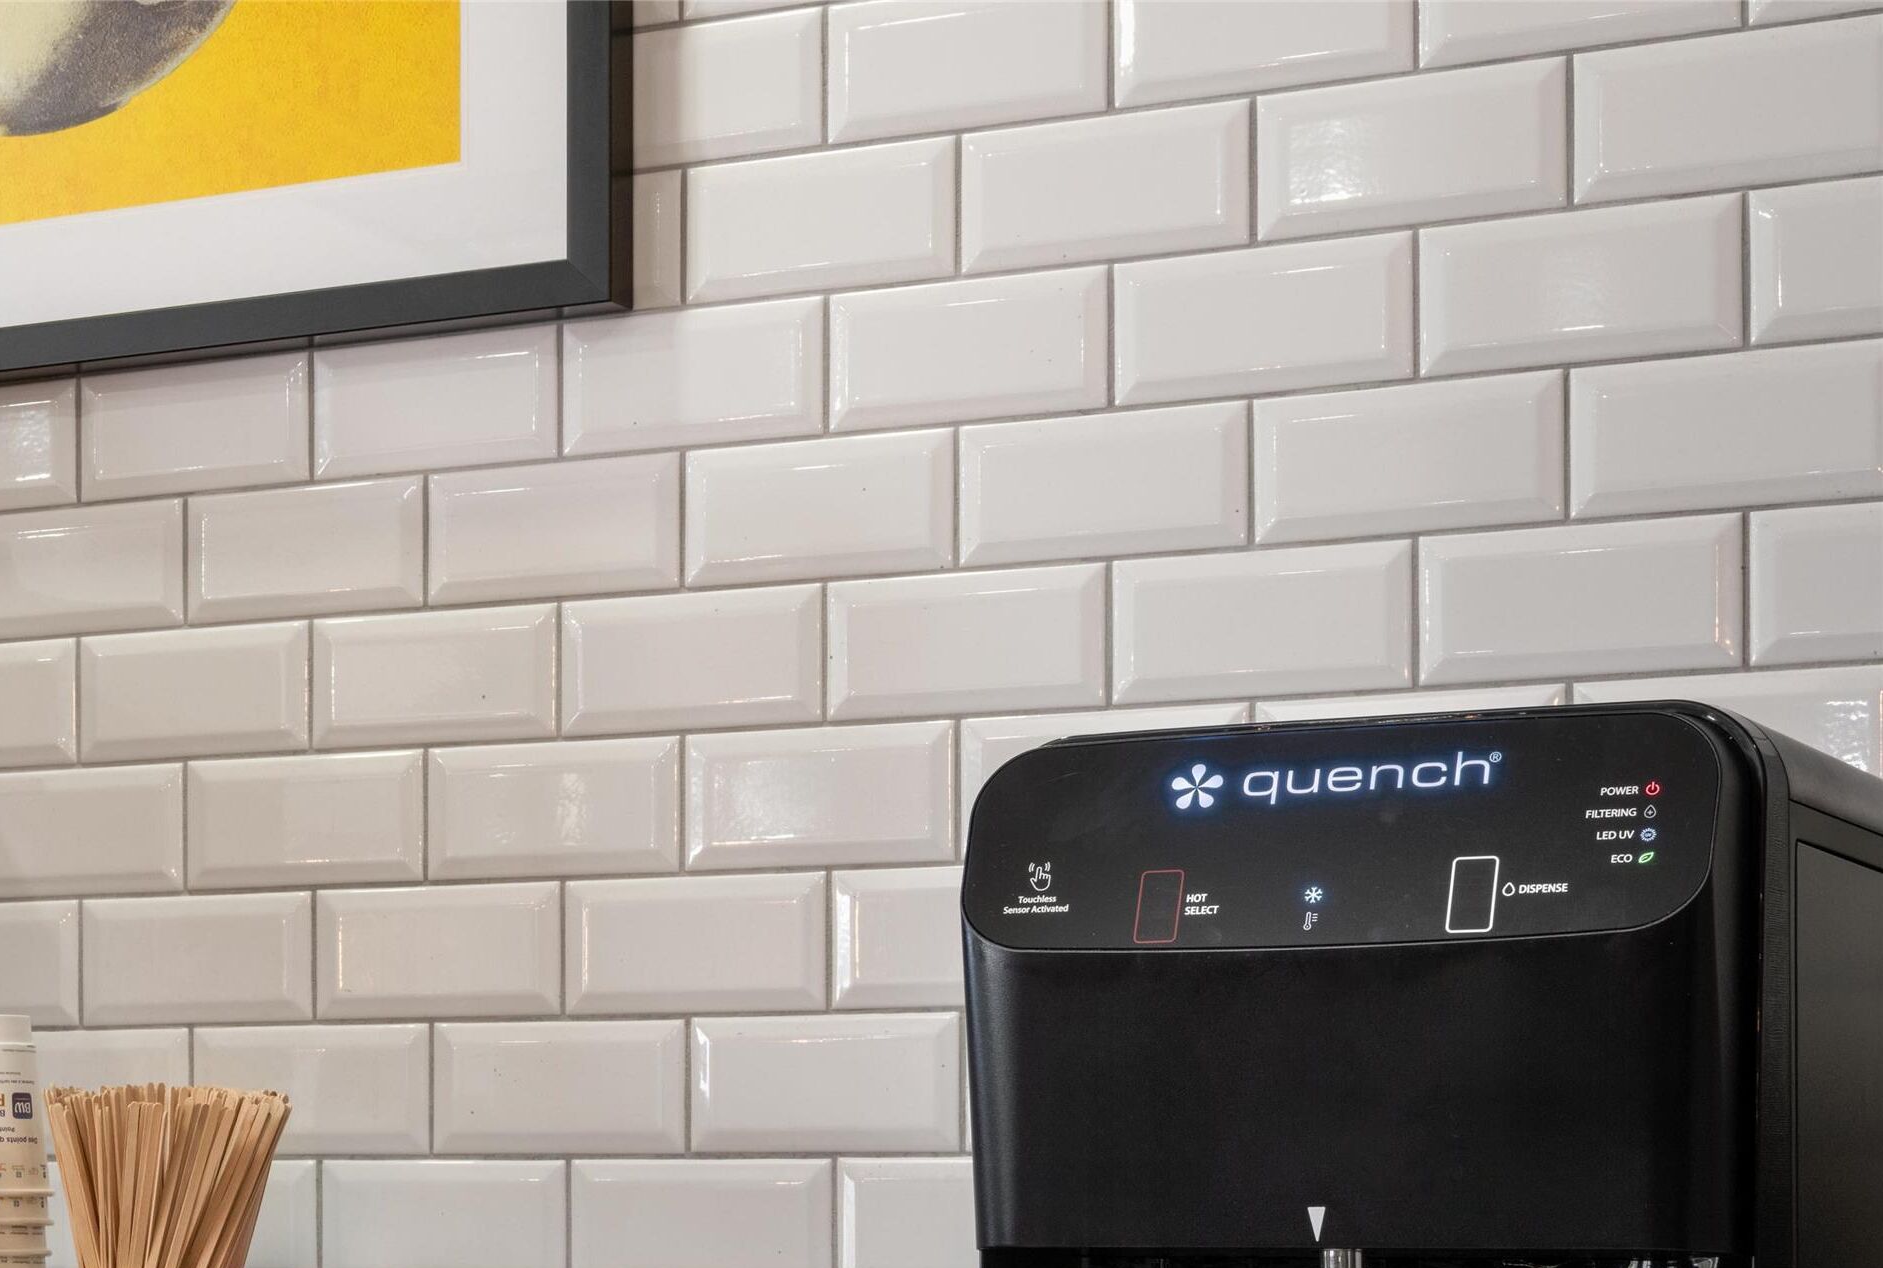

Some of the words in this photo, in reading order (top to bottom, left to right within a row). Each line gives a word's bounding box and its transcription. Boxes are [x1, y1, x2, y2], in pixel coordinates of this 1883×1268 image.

[1600, 786, 1639, 796] POWER
[1585, 807, 1637, 819] FILTERING
[1596, 831, 1616, 840] LED
[1618, 830, 1635, 839] UV
[1610, 854, 1633, 863] ECO
[1518, 883, 1568, 894] DISPENSE
[1018, 896, 1057, 904] Touchless
[1186, 893, 1207, 903] HOT
[1003, 906, 1030, 914] Sensor
[1031, 904, 1069, 914] Activated
[1184, 905, 1219, 915] SELECT
[14, 1102, 31, 1114] BW
[6, 1136, 27, 1144] points
